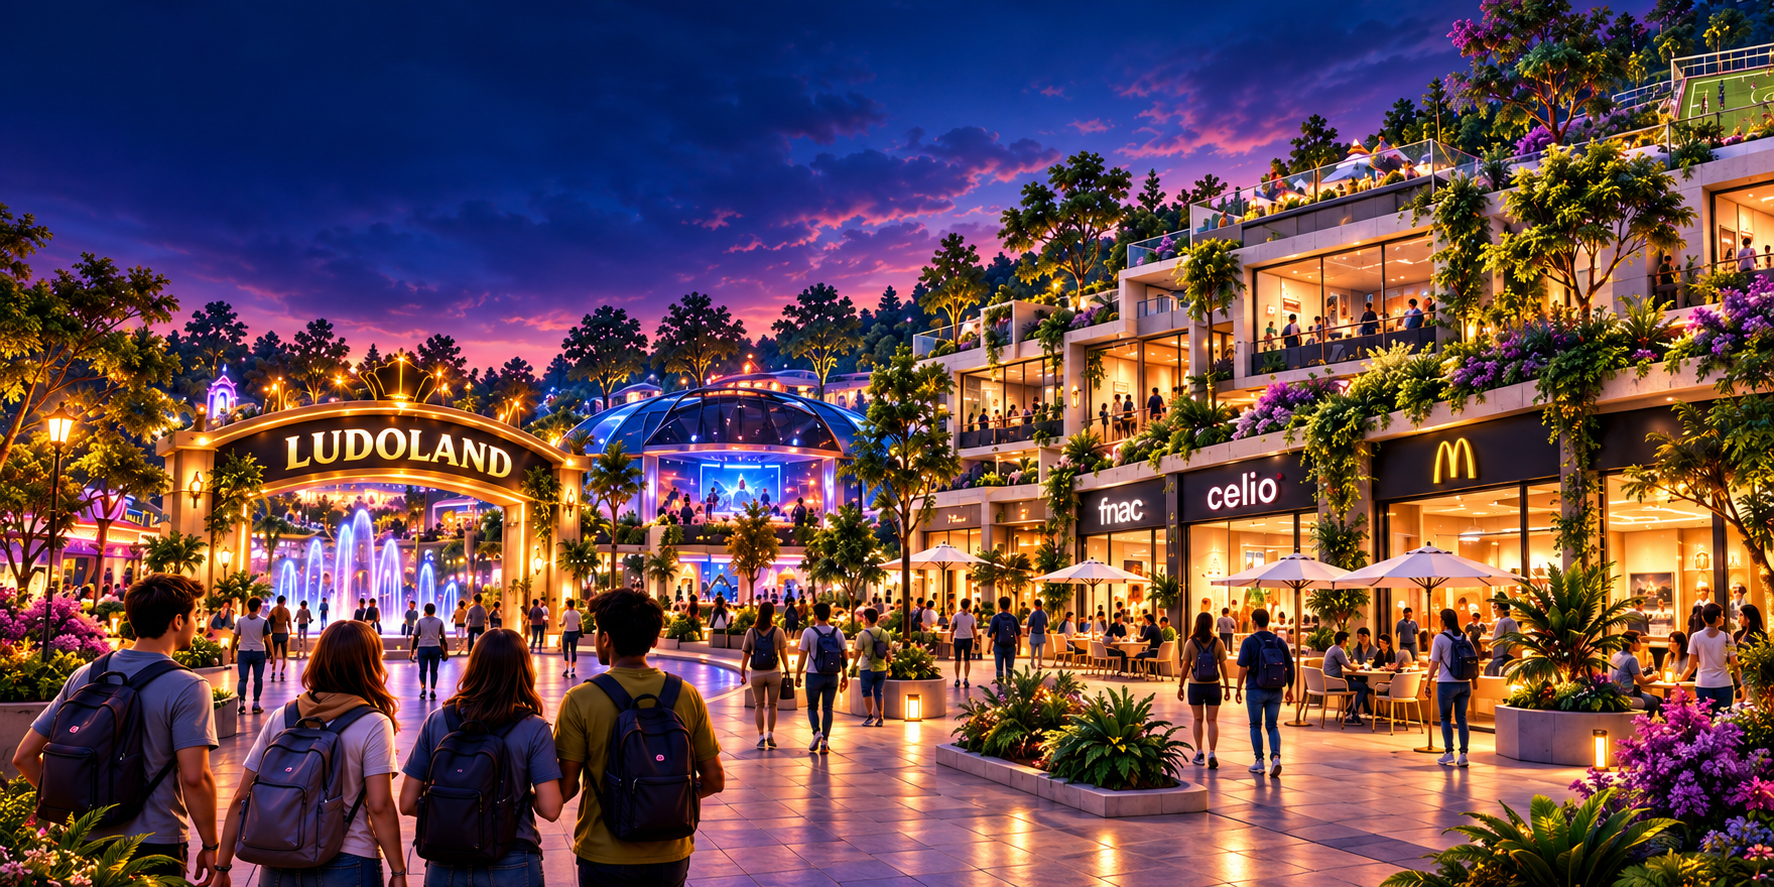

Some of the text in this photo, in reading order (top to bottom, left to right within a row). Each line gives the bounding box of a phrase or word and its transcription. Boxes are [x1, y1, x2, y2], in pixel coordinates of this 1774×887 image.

[285, 428, 512, 478] LUDOLAND
[1207, 472, 1279, 510] celio
[1098, 497, 1144, 525] fnac
